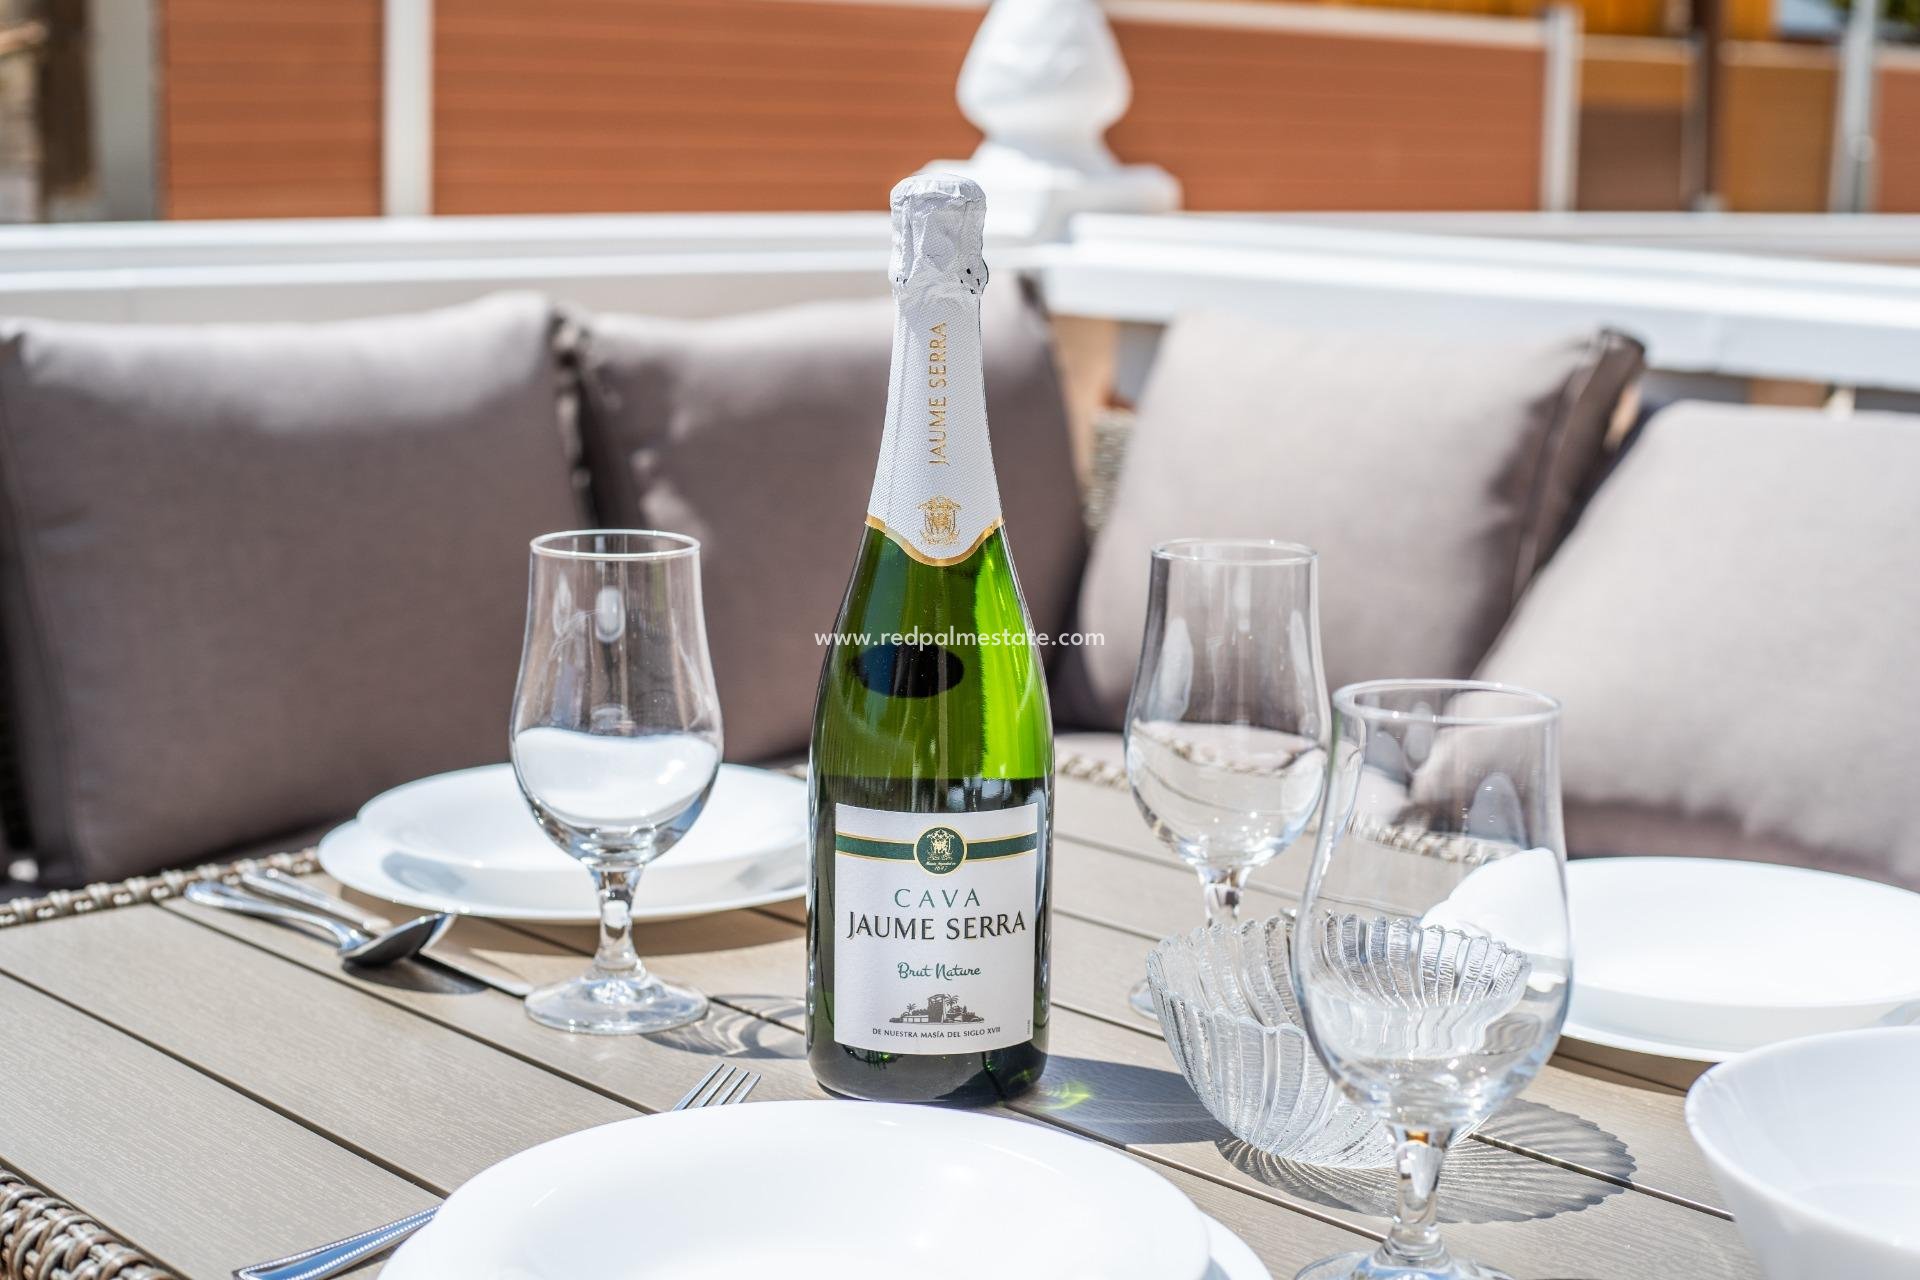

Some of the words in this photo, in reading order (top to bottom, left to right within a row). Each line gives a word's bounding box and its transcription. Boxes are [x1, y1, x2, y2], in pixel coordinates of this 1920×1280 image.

[928, 321, 947, 388] SERRA
[928, 396, 950, 465] JAUME
[894, 888, 981, 908] CAVA
[846, 911, 935, 940] JAUME
[946, 910, 1026, 940] SERRA
[897, 962, 933, 980] Brut
[936, 963, 982, 981] Nature
[884, 1029, 918, 1038] NUESTRA
[921, 1030, 945, 1038] MASÍA
[963, 1029, 985, 1037] SIGLO
